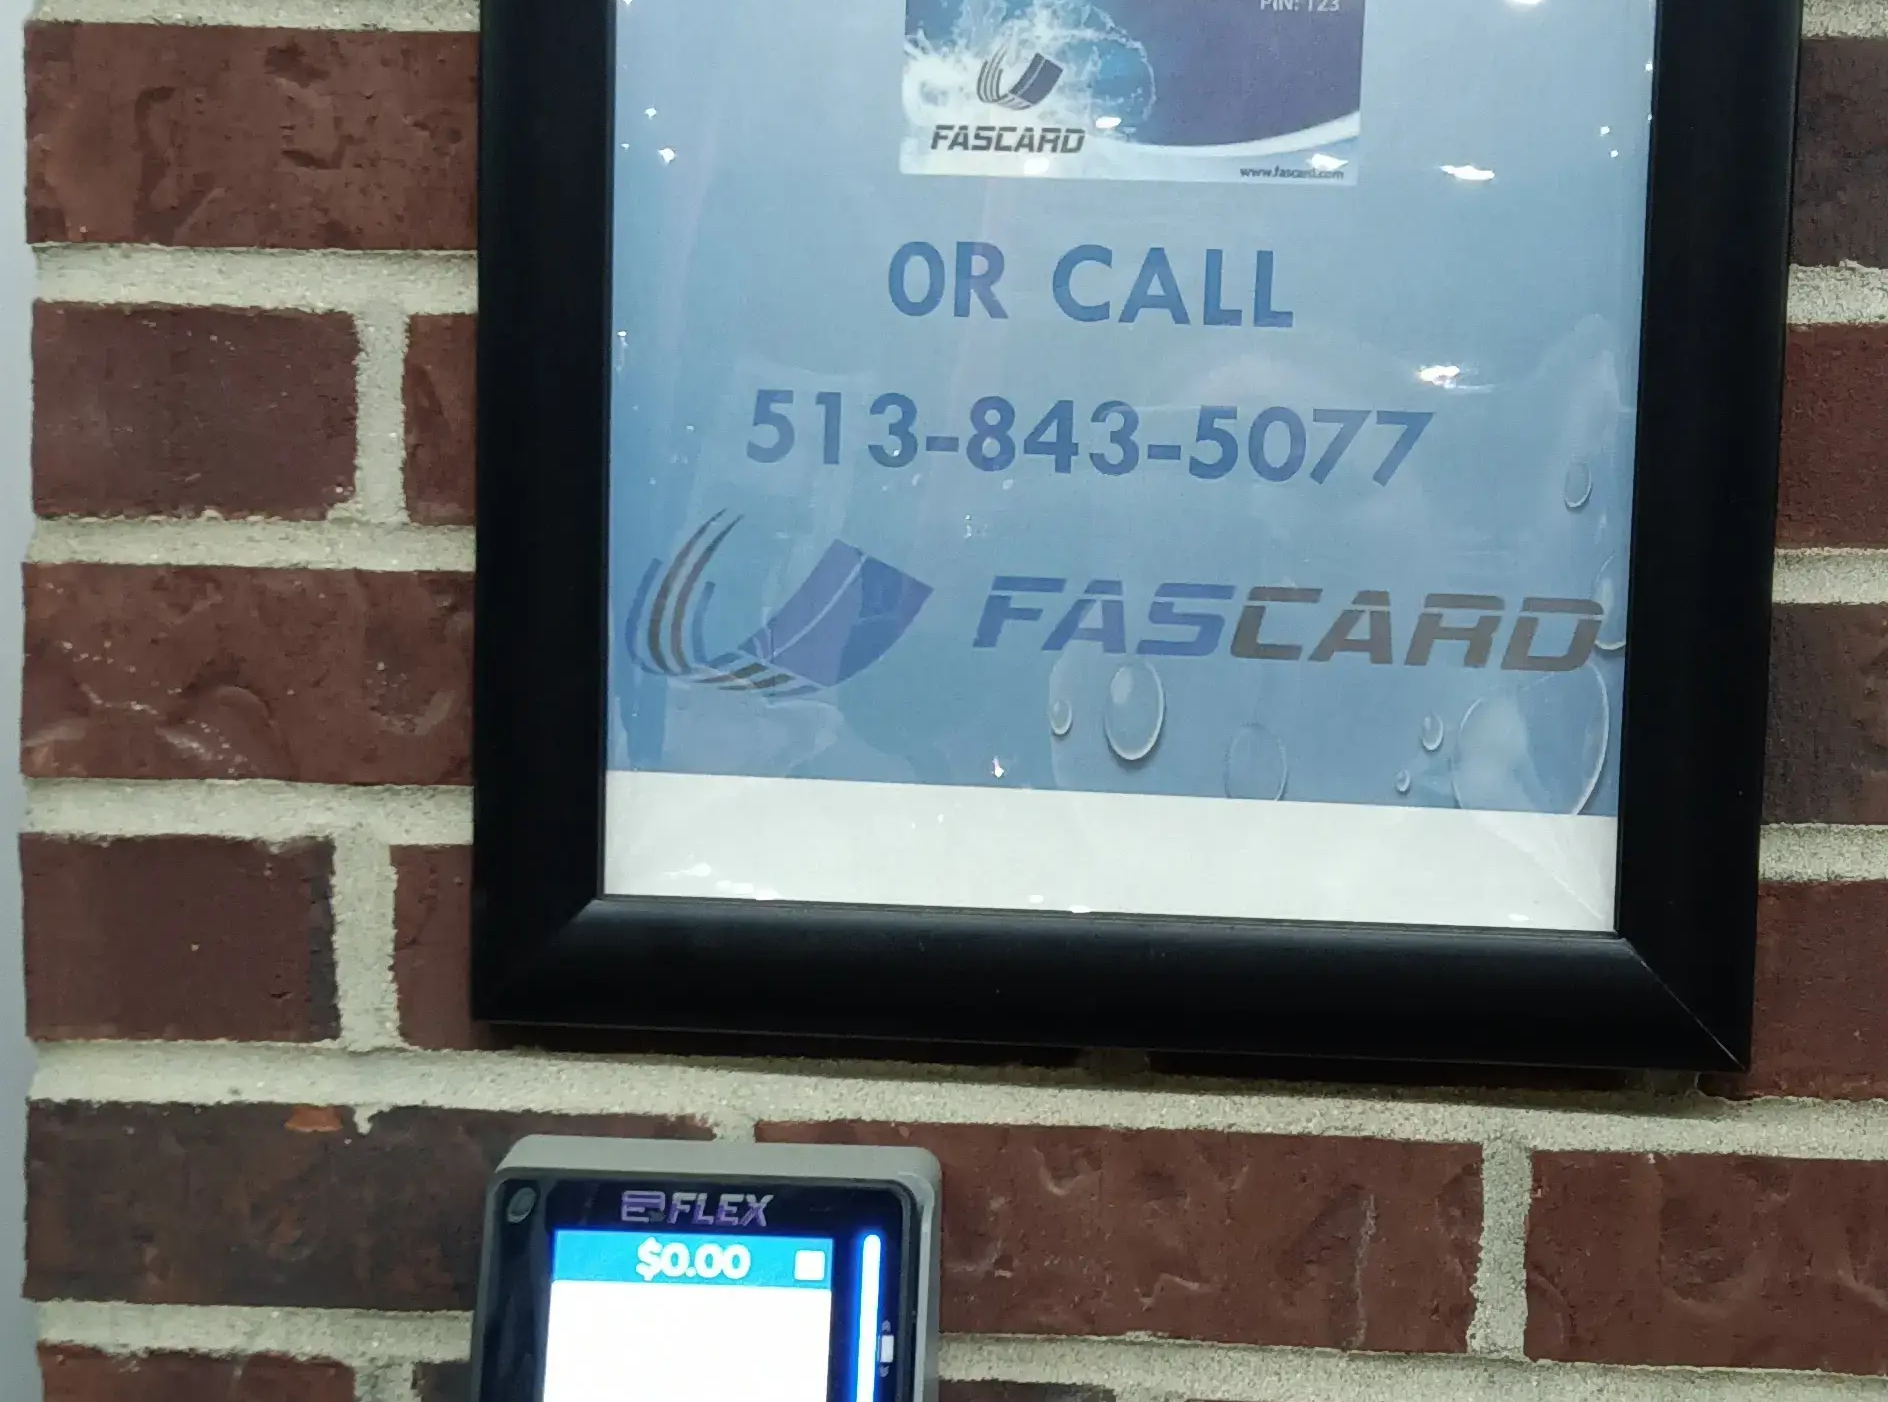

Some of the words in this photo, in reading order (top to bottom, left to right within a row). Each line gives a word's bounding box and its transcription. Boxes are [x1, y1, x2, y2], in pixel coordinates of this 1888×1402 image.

[931, 124, 1085, 154] FASCARD
[1051, 244, 1295, 328] CALL
[745, 389, 1435, 487] 513-843-5077
[973, 576, 1605, 673] FASCARD
[666, 1192, 775, 1227] FLEX
[635, 1236, 752, 1281] $0.00
